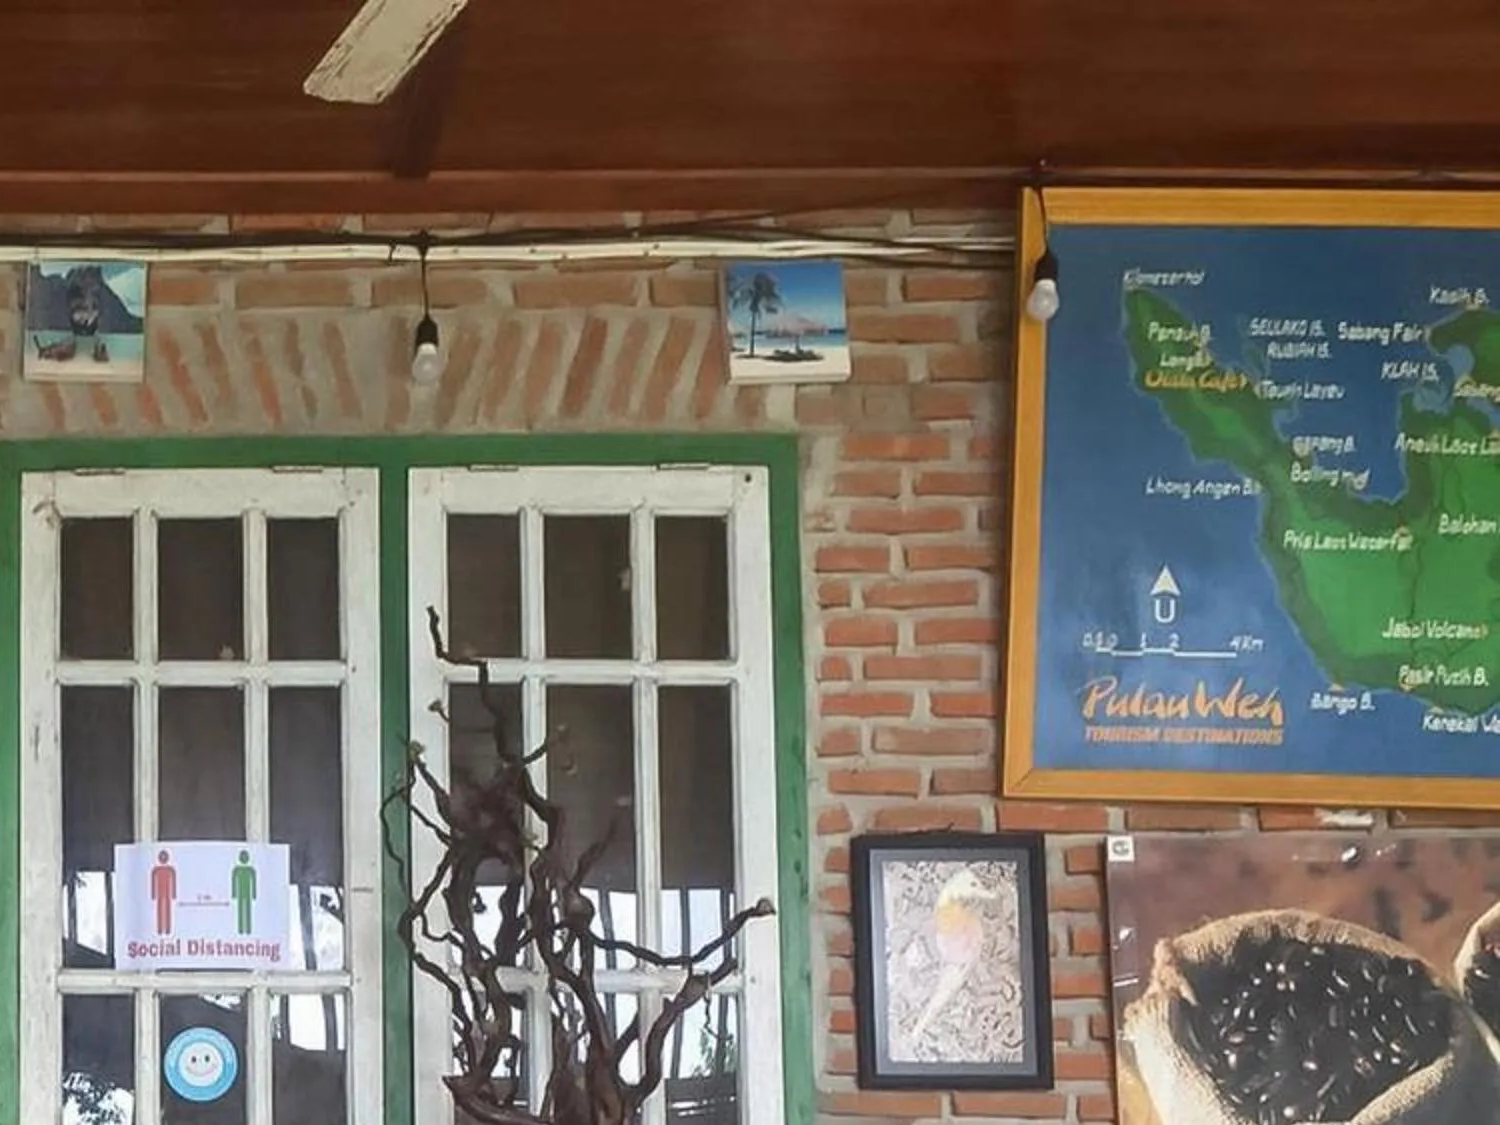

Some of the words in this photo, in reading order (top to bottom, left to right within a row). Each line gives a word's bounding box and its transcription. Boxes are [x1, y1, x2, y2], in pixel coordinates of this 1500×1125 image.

[1154, 598, 1176, 624] U
[1082, 674, 1190, 721] Pulau
[1193, 676, 1285, 727] Weh
[127, 939, 181, 959] Social
[187, 937, 282, 963] Distancing
